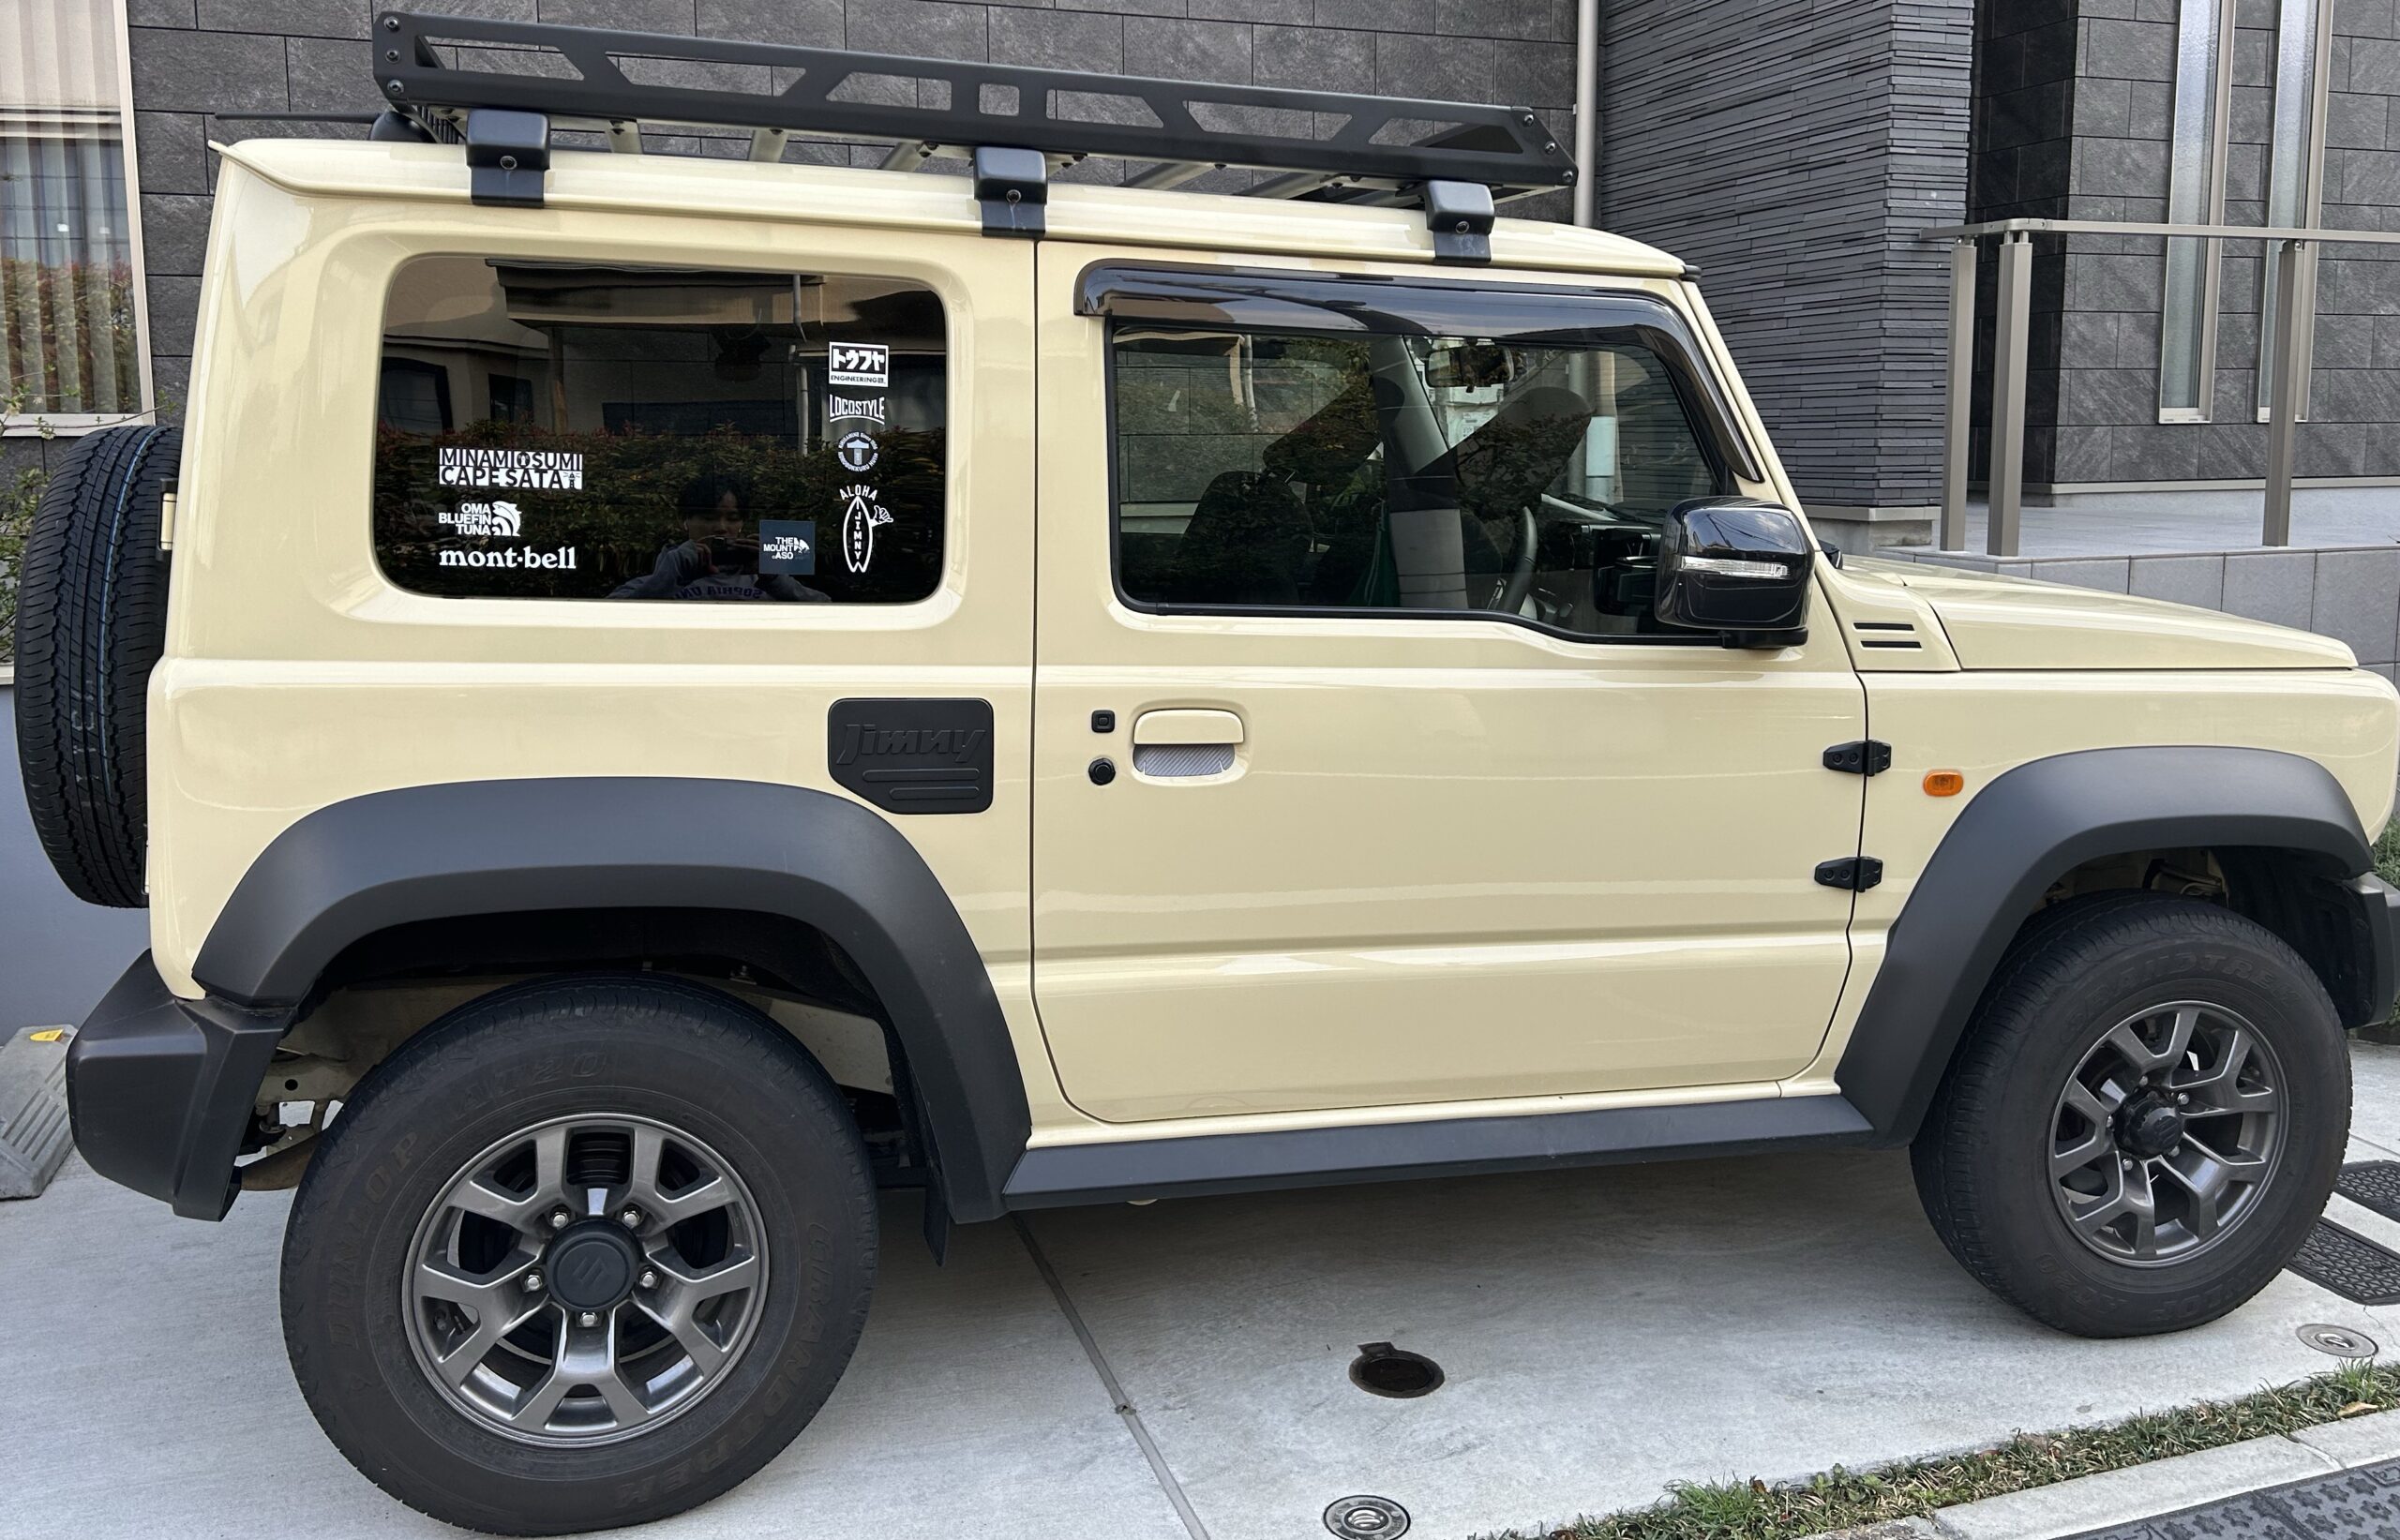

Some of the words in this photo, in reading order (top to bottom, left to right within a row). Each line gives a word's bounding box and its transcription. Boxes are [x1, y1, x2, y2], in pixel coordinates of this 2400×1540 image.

[832, 348, 885, 371] トウフヤ
[831, 375, 878, 383] ENGINEERING
[829, 394, 885, 420] LOCOSTYLE
[440, 448, 582, 470] MINAMIOSUMI
[441, 467, 500, 486] CAPE
[505, 468, 563, 488] SATA
[839, 485, 878, 501] ALOHA
[438, 513, 492, 525] BLUEFIN
[461, 502, 491, 515] OMA
[456, 524, 491, 535] TUNA
[853, 512, 862, 561] JIMNY
[763, 544, 794, 552] MOUNT
[774, 536, 794, 545] THE
[835, 724, 986, 766] Jimny
[454, 1050, 609, 1122] AT20
[327, 1132, 419, 1351] DUNLOP
